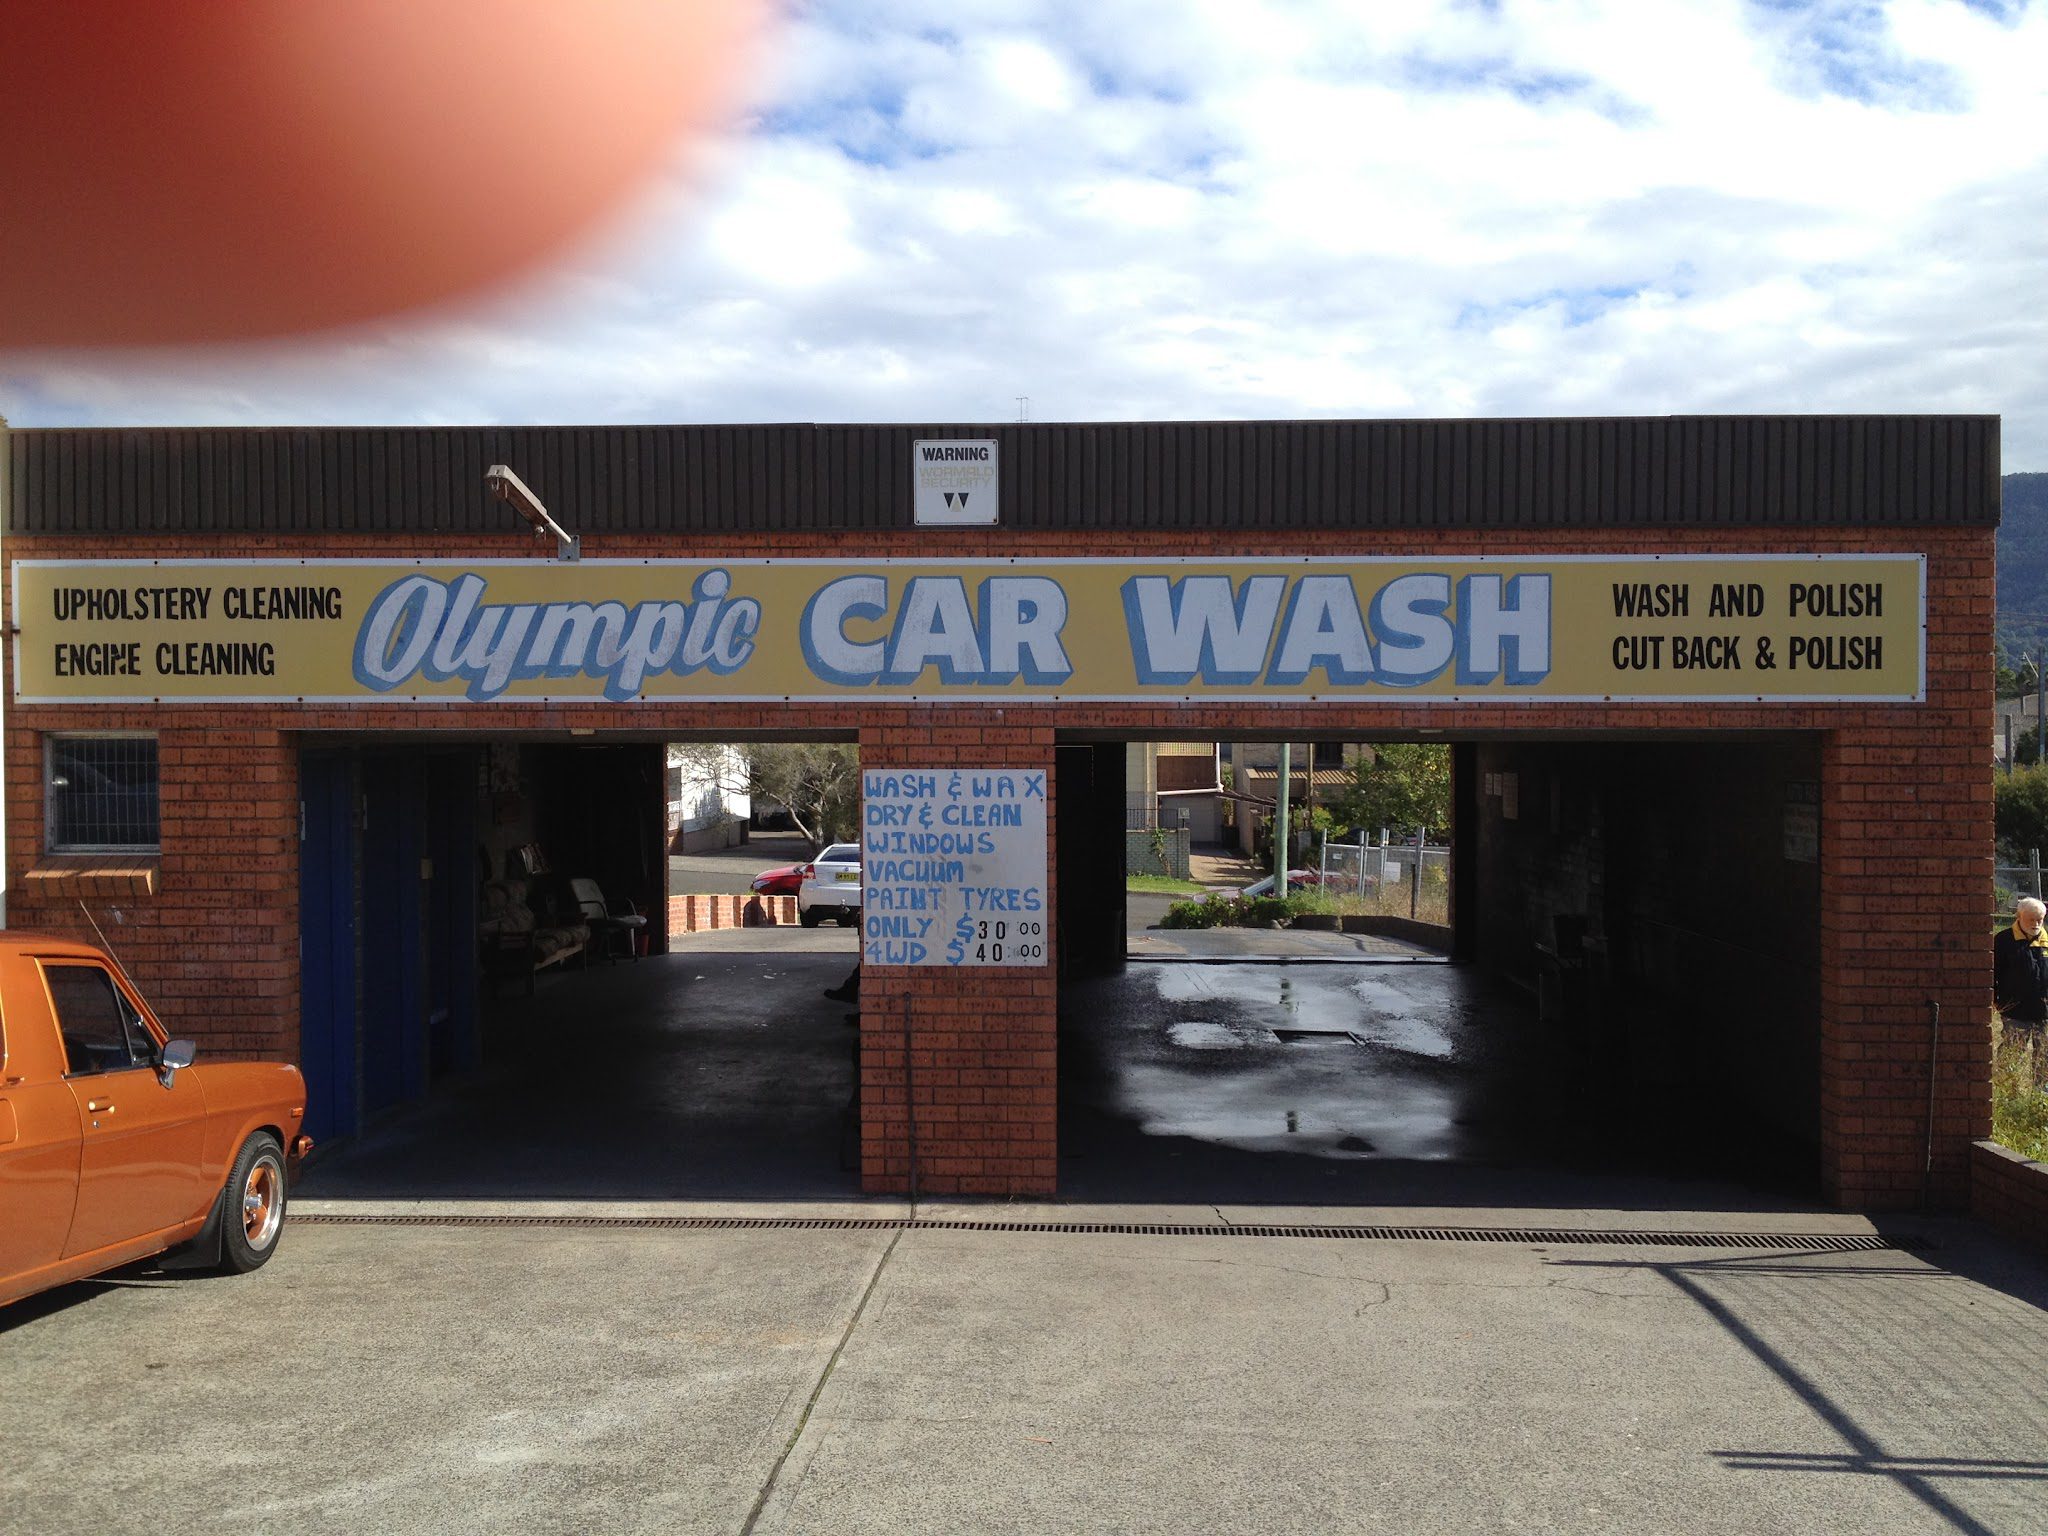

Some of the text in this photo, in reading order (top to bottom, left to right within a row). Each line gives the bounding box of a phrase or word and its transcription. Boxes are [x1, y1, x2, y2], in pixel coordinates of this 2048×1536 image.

[922, 447, 989, 461] WARNING
[54, 587, 342, 620] UPHOLSTERY CLEANING
[1612, 583, 1883, 617] WASH AND POLISH
[352, 568, 1551, 702] Olympic CAR WASH
[55, 642, 275, 676] ENGINE CLEANING
[1612, 636, 1883, 670] CUT BACK & POLISH
[865, 772, 1044, 801] WASH & WAX
[867, 802, 1022, 829] DRY & CLEAN
[867, 832, 995, 854] WINDOWS
[868, 860, 964, 883] VACUUM
[866, 887, 1041, 911] PAINT TYRES
[866, 916, 933, 938] ONLY
[866, 941, 927, 964] 4WD
